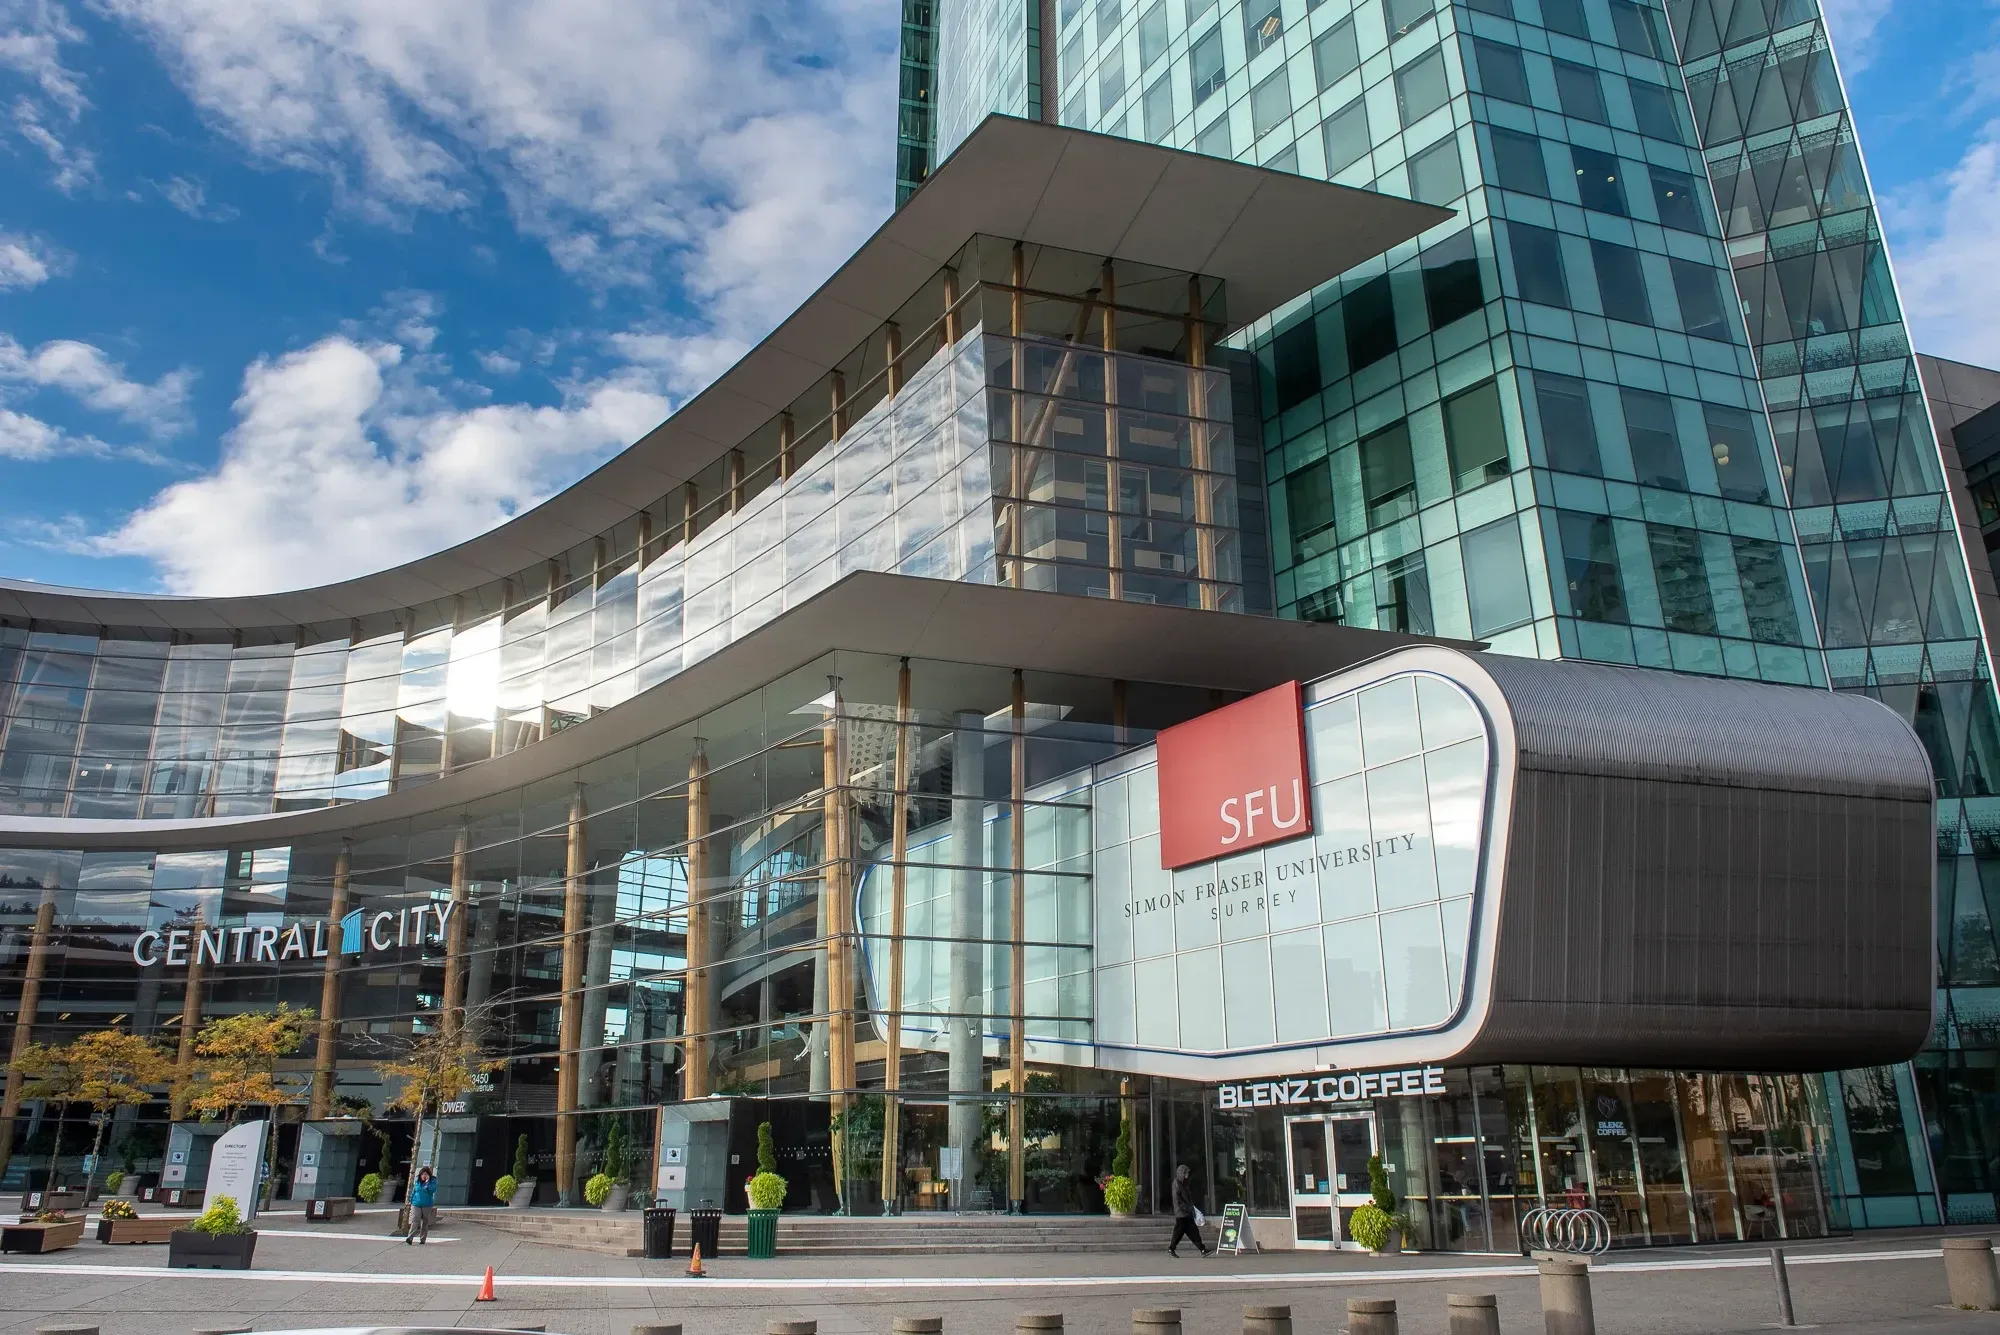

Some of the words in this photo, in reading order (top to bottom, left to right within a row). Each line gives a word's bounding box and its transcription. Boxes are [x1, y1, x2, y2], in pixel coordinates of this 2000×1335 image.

[1220, 778, 1301, 845] SFU
[1124, 889, 1186, 918] SIMON
[1195, 870, 1265, 901] FRASER
[1276, 832, 1416, 882] UNIVERSITY
[1211, 889, 1297, 920] SURREY
[133, 920, 328, 967] CENTRAL
[370, 900, 456, 951] CITY
[469, 1073, 489, 1084] 3450
[1219, 1080, 1310, 1109] BLENZ
[1317, 1067, 1446, 1102] COFFEE
[442, 1101, 465, 1113] OWER
